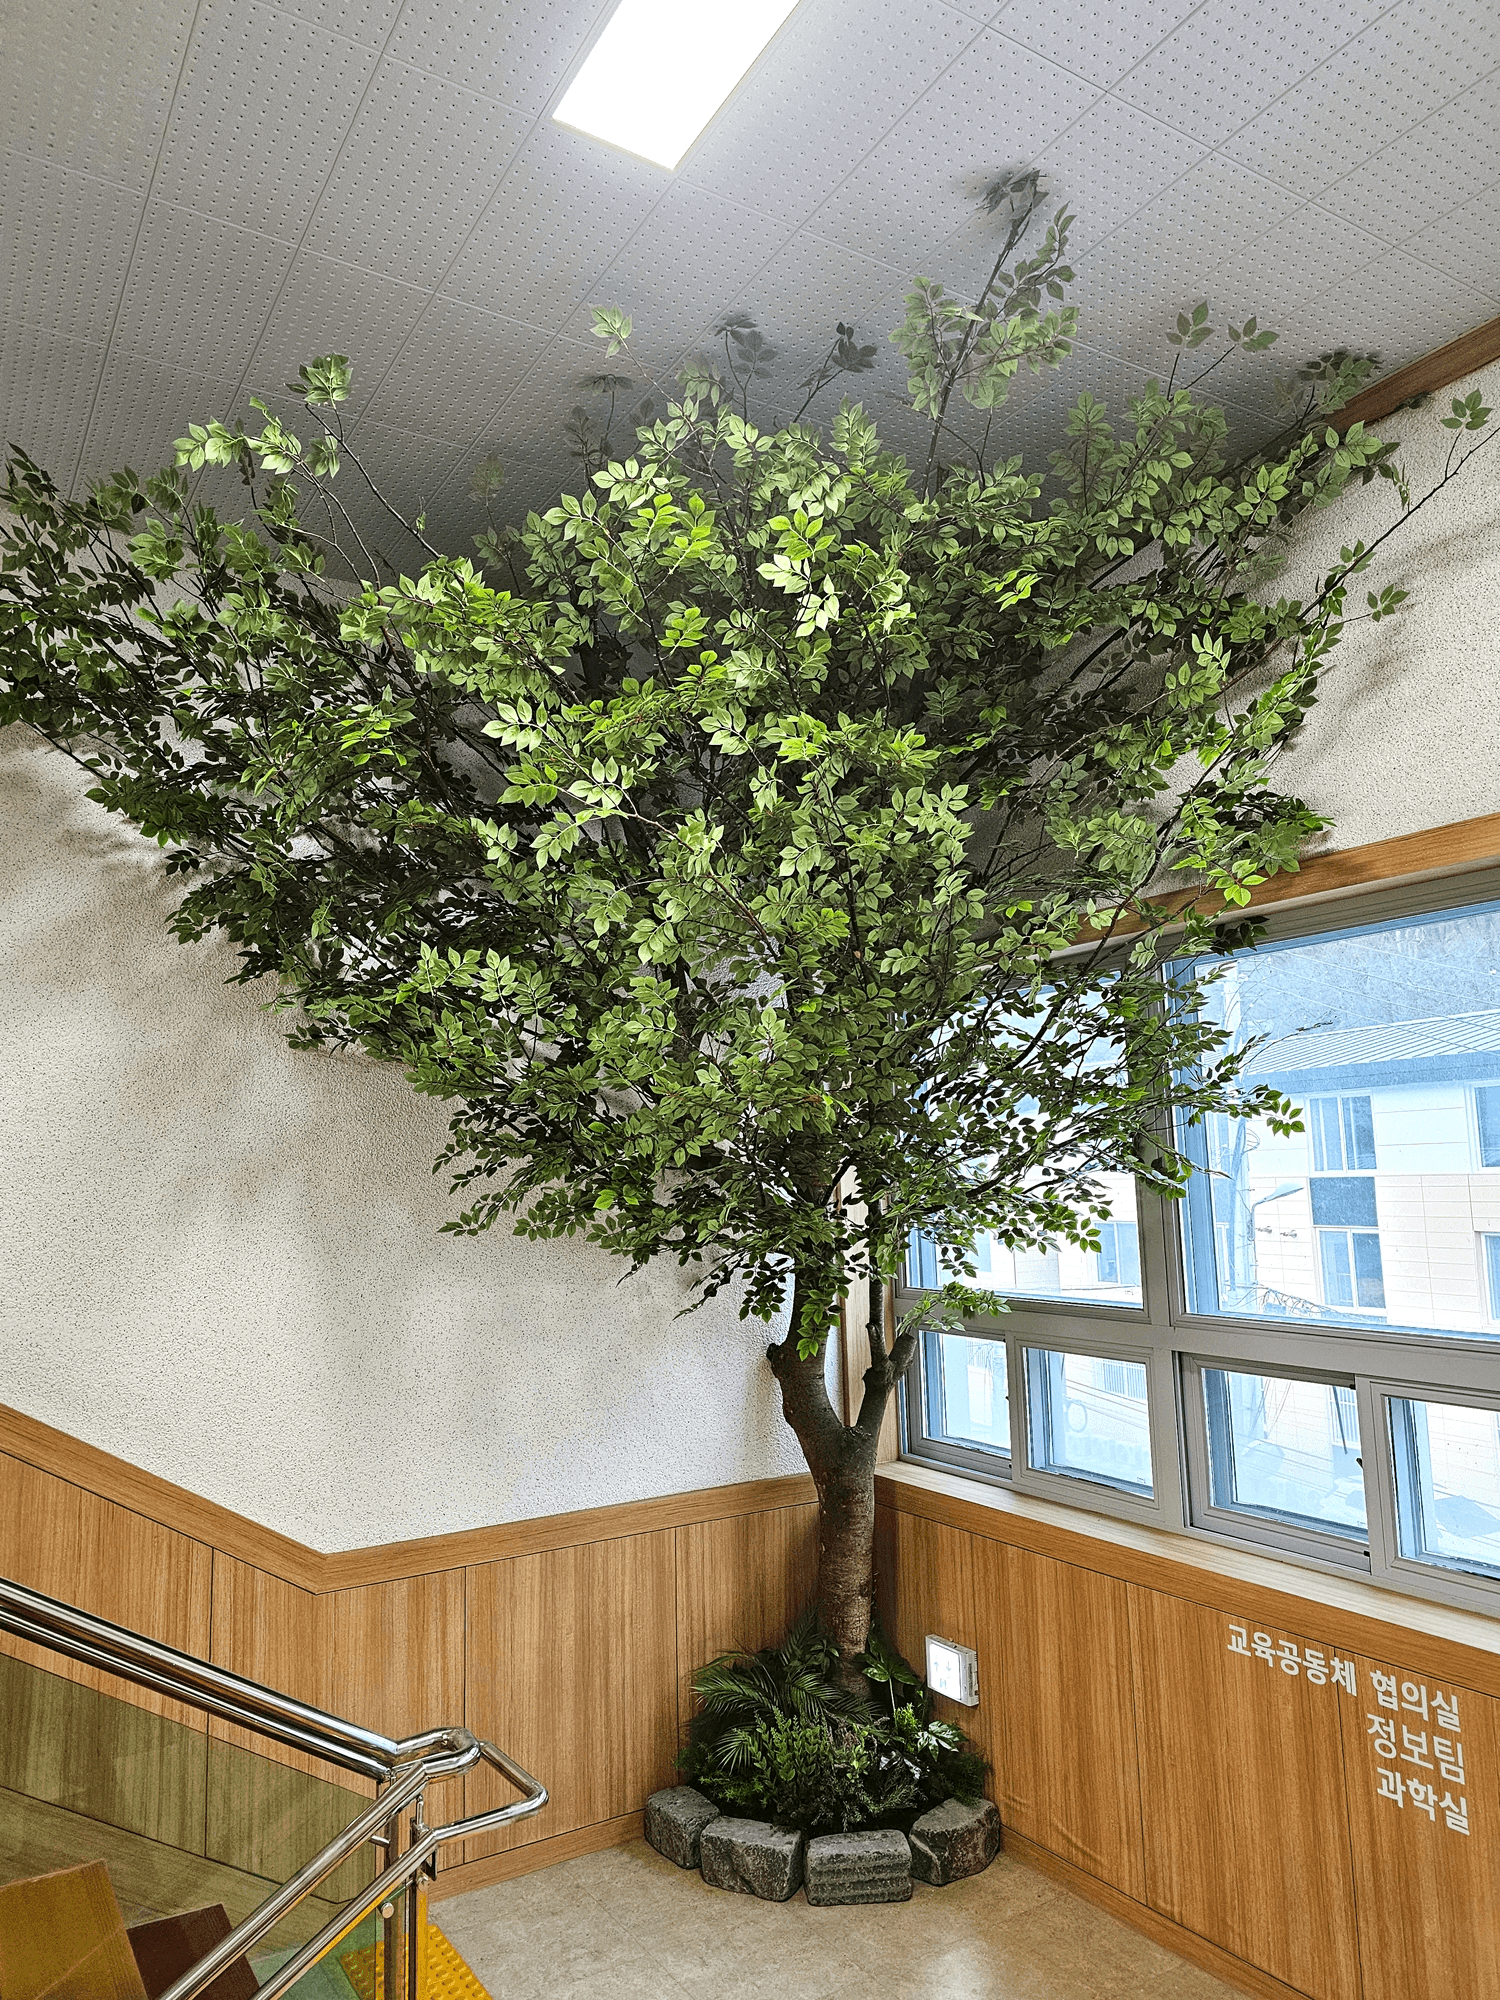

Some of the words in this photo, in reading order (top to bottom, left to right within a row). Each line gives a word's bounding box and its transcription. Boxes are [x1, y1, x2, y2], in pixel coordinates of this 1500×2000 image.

[1227, 1623, 1357, 1697] 교육공동체
[1370, 1669, 1461, 1733] 협의실
[1367, 1713, 1465, 1785] 정보팀
[1376, 1767, 1470, 1836] 과학실
